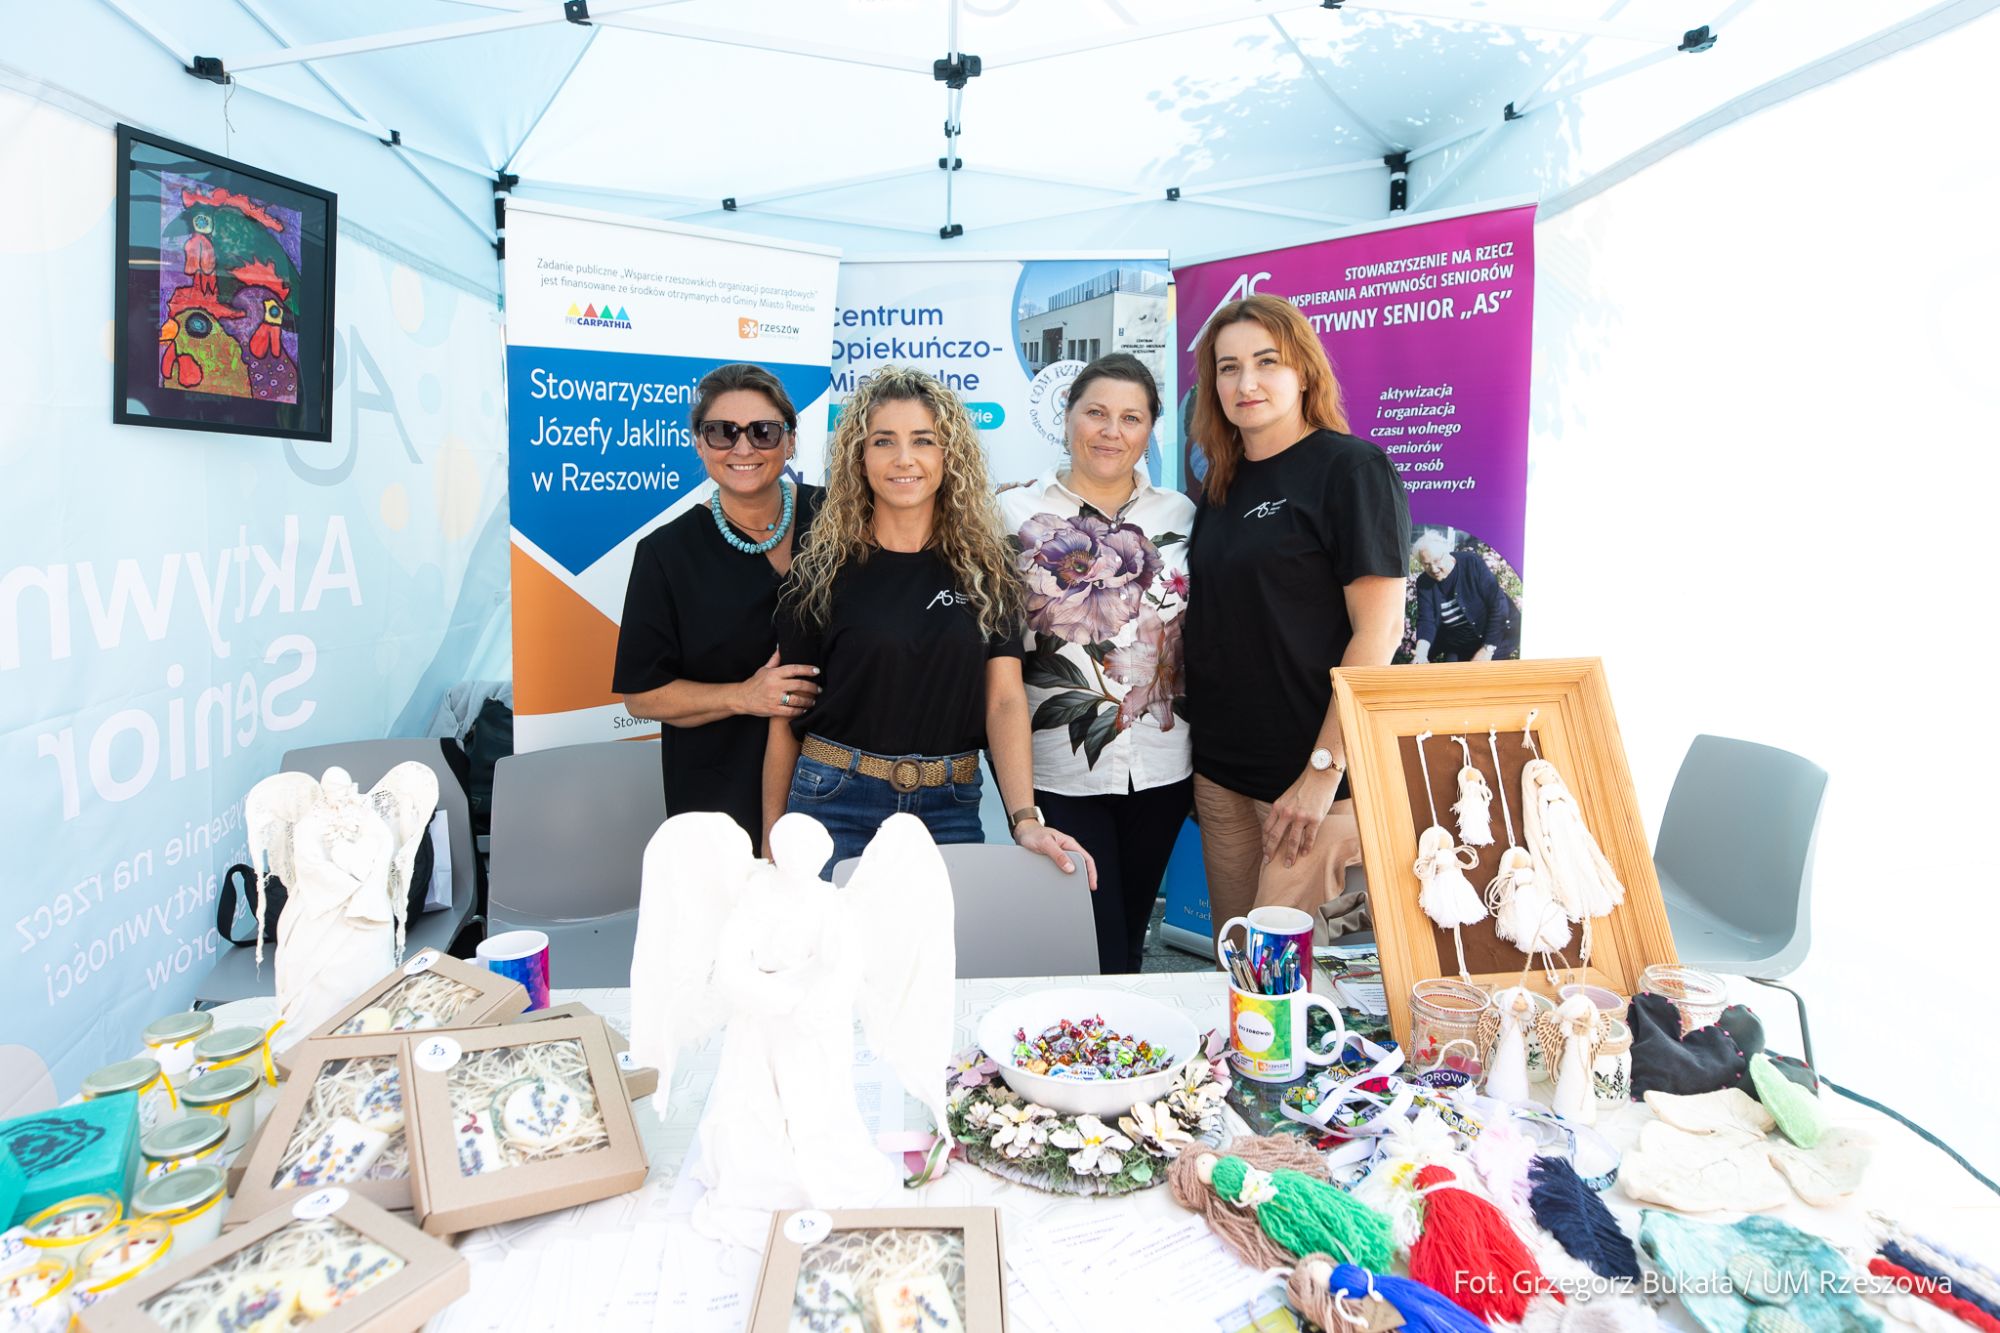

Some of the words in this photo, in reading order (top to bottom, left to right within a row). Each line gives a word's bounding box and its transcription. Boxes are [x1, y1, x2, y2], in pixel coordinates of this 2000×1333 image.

[1345, 252, 1447, 281] STOWARZYSZENIE
[1451, 249, 1472, 265] NA
[1475, 241, 1514, 261] RZECZ
[537, 258, 574, 272] Zadanie
[576, 264, 618, 278] publiczne
[665, 274, 716, 289] rzeszowskich
[719, 281, 758, 295] organizacji
[1288, 287, 1357, 308] WSPIERANIA
[1359, 274, 1437, 299] AKTYWNOŚCI
[1441, 263, 1514, 287] SENIORÓW
[541, 274, 558, 287] jest
[561, 276, 616, 292] finansowane
[618, 285, 628, 293] ze
[630, 283, 665, 297] środków
[668, 289, 719, 303] otrzymanych
[721, 294, 731, 304] od
[733, 296, 757, 308] Gminy
[760, 299, 784, 310] Miasto
[786, 301, 816, 313] Rzeszów
[760, 323, 800, 334] rzeszów
[834, 305, 943, 327] entrum
[1308, 308, 1378, 334] TYWNY
[1383, 297, 1454, 326] SENIOR
[831, 335, 1003, 365] Opiekuńczo-
[1379, 383, 1453, 403] aktywizacja
[1376, 406, 1383, 418] i
[1384, 402, 1456, 421] organizacja
[530, 416, 612, 455] Józefy
[1370, 425, 1404, 438] czasu
[1408, 421, 1461, 437] wolnego
[1386, 440, 1444, 454] seniorów
[532, 471, 553, 492] w
[562, 463, 680, 492] Rzeszowie
[1414, 458, 1445, 472] osób
[1443, 1110, 1478, 1137] ZDRO
